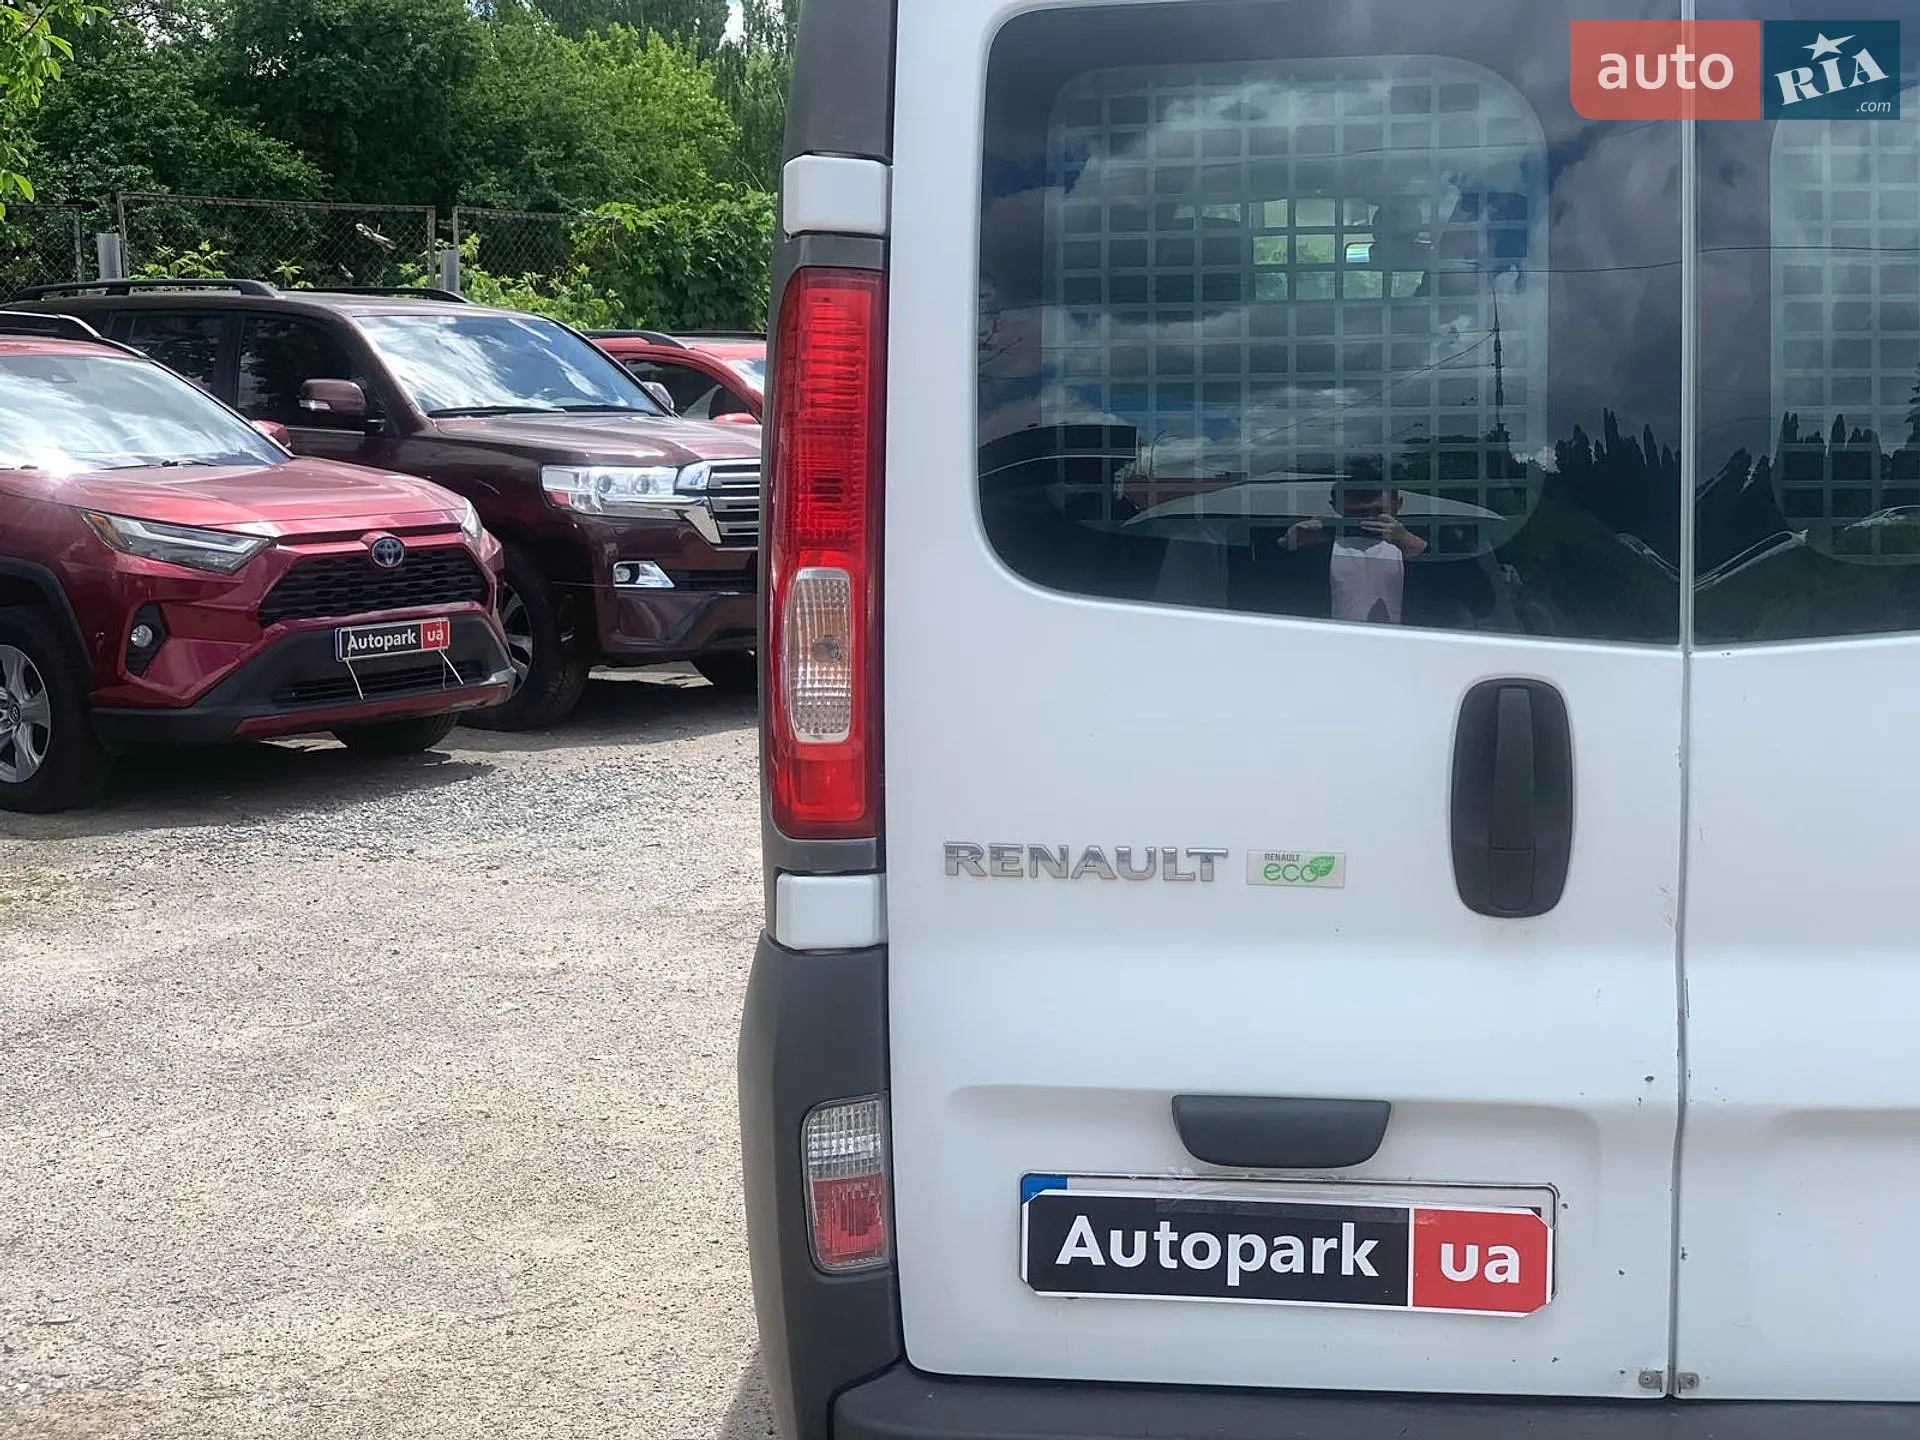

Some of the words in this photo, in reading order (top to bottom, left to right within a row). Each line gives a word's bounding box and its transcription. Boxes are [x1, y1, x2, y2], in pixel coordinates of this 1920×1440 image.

[347, 628, 417, 651] Autopark
[427, 630, 443, 642] ua
[943, 841, 1229, 882] RENAULT
[1264, 853, 1300, 862] RENAULT
[1263, 863, 1319, 882] eco
[1054, 1215, 1380, 1287] Autopark
[1439, 1241, 1520, 1284] ua
